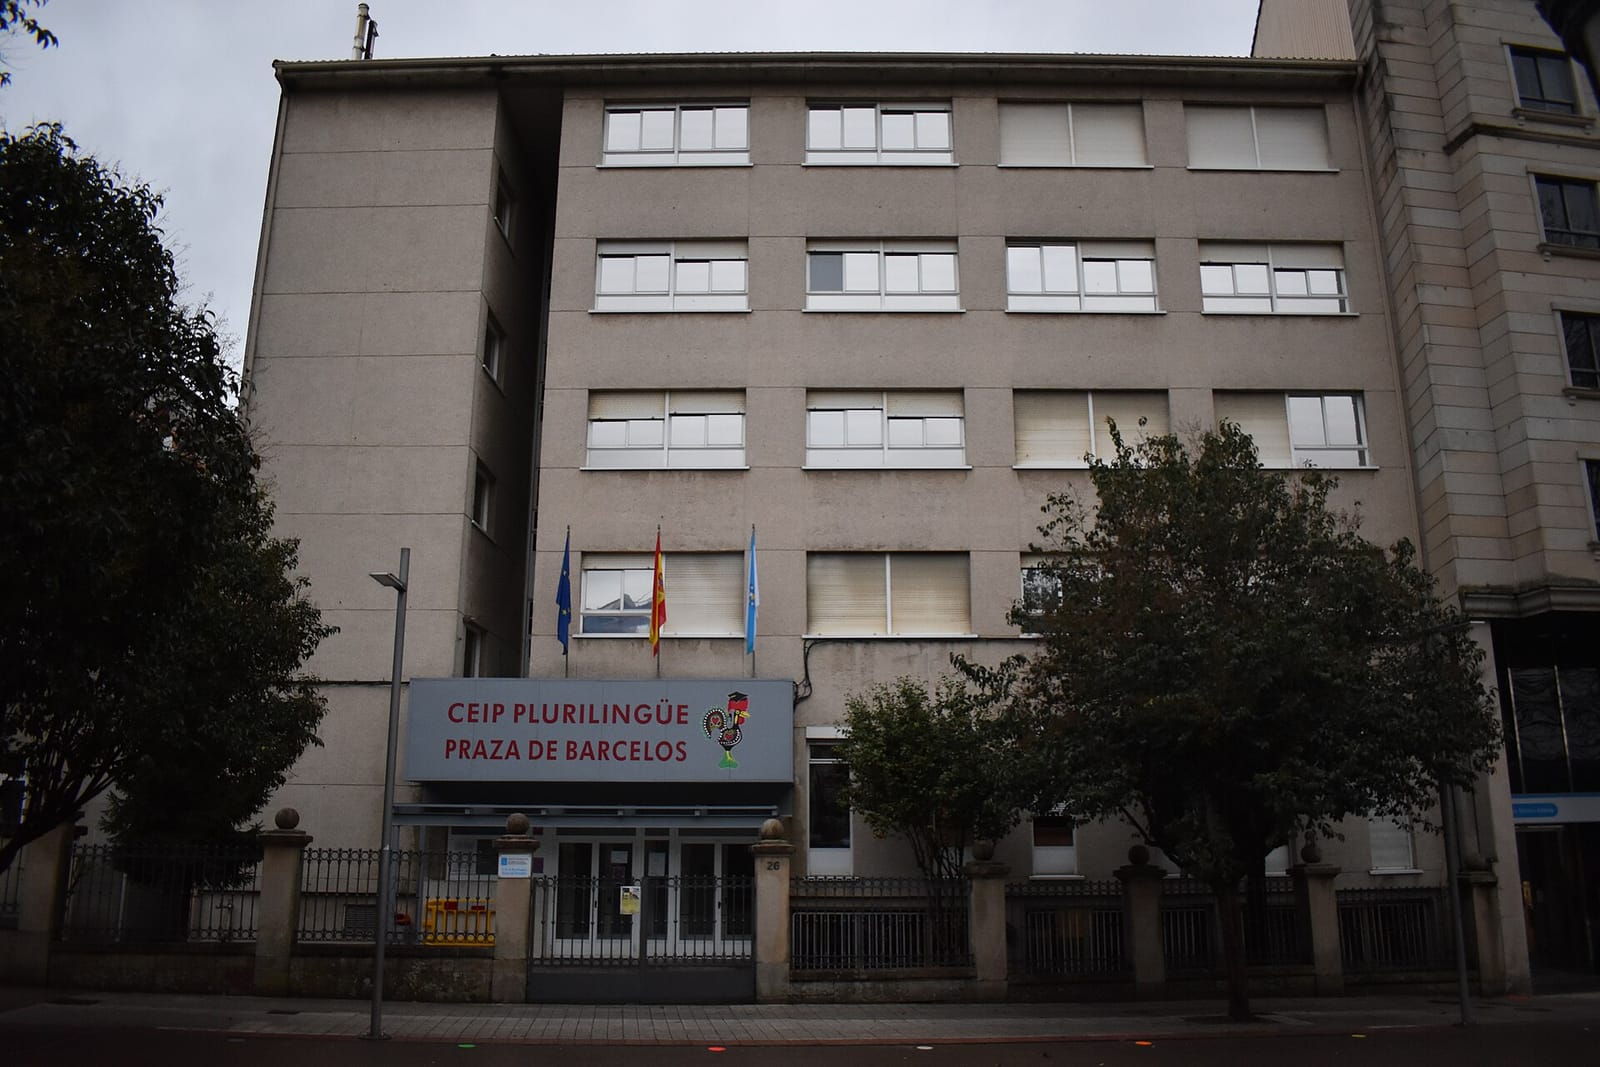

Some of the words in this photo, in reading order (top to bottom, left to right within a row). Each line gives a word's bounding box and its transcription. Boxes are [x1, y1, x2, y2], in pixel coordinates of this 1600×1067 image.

[448, 702, 505, 723] CEIP
[513, 699, 689, 725] PLURILINGÜE
[445, 739, 520, 760] PRAZA
[528, 740, 557, 761] DE
[566, 740, 687, 762] BARCELOS
[767, 862, 780, 870] 26
